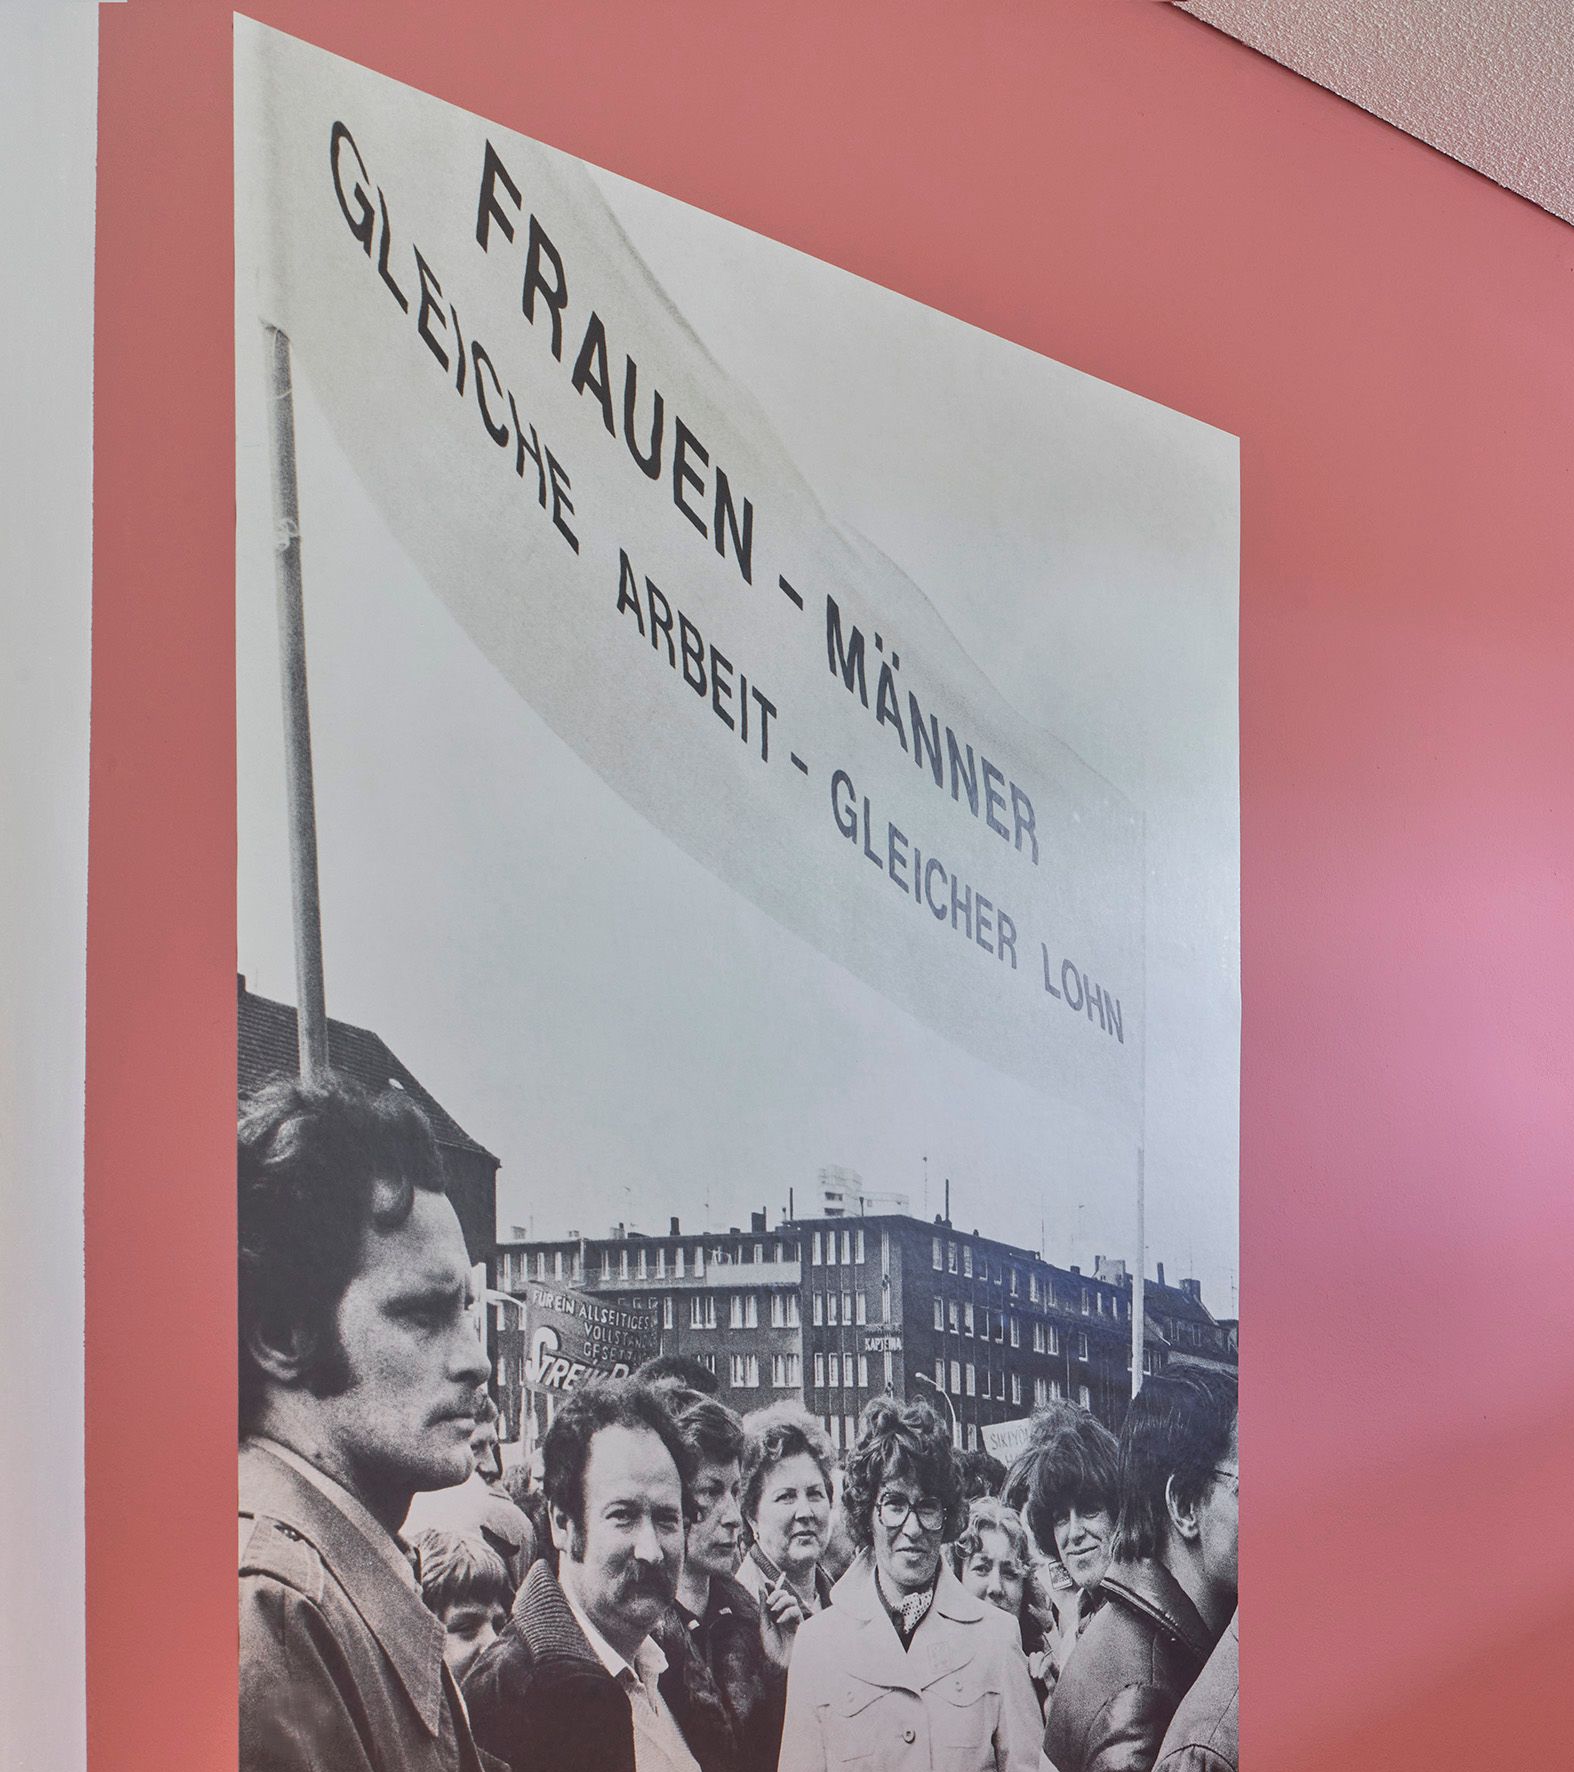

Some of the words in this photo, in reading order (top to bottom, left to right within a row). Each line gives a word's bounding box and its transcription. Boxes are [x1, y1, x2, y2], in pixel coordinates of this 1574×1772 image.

[329, 120, 580, 556] GLEICHE
[830, 769, 1018, 970] GLEICHER
[1041, 943, 1124, 1045] LOHN
[475, 138, 755, 586] FRAUEN
[826, 594, 1040, 865] MÄNNER
